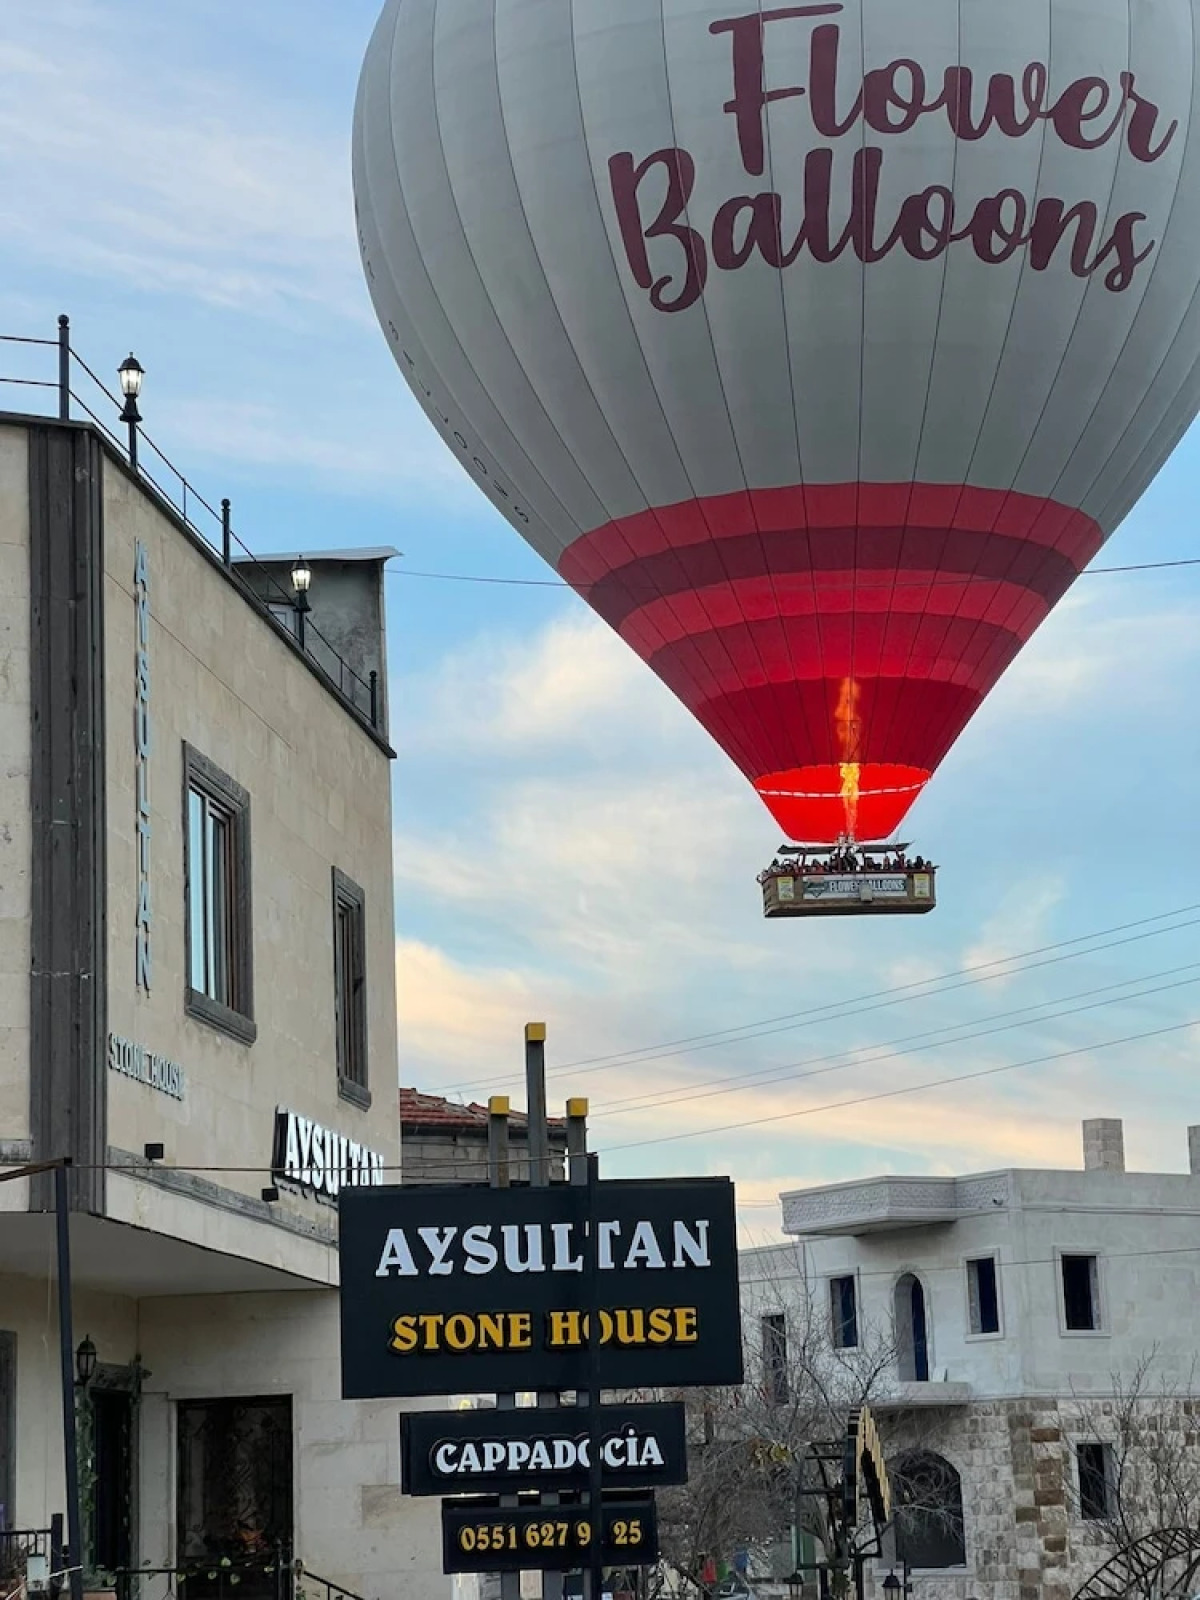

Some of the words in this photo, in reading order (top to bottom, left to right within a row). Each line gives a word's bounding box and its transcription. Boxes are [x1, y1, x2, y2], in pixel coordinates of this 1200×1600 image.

[708, 3, 1178, 176] Flower
[608, 147, 1155, 313] Balloons
[135, 537, 151, 998] AYSULTAN
[284, 1112, 384, 1195] AYSULTAN
[375, 1219, 712, 1277] AYSULTAN
[391, 1313, 532, 1352] STONE
[550, 1307, 698, 1346] HOUSE
[461, 1526, 517, 1551] 0551
[525, 1522, 569, 1548] 627
[577, 1521, 599, 1546] 9
[613, 1520, 642, 1545] 25
